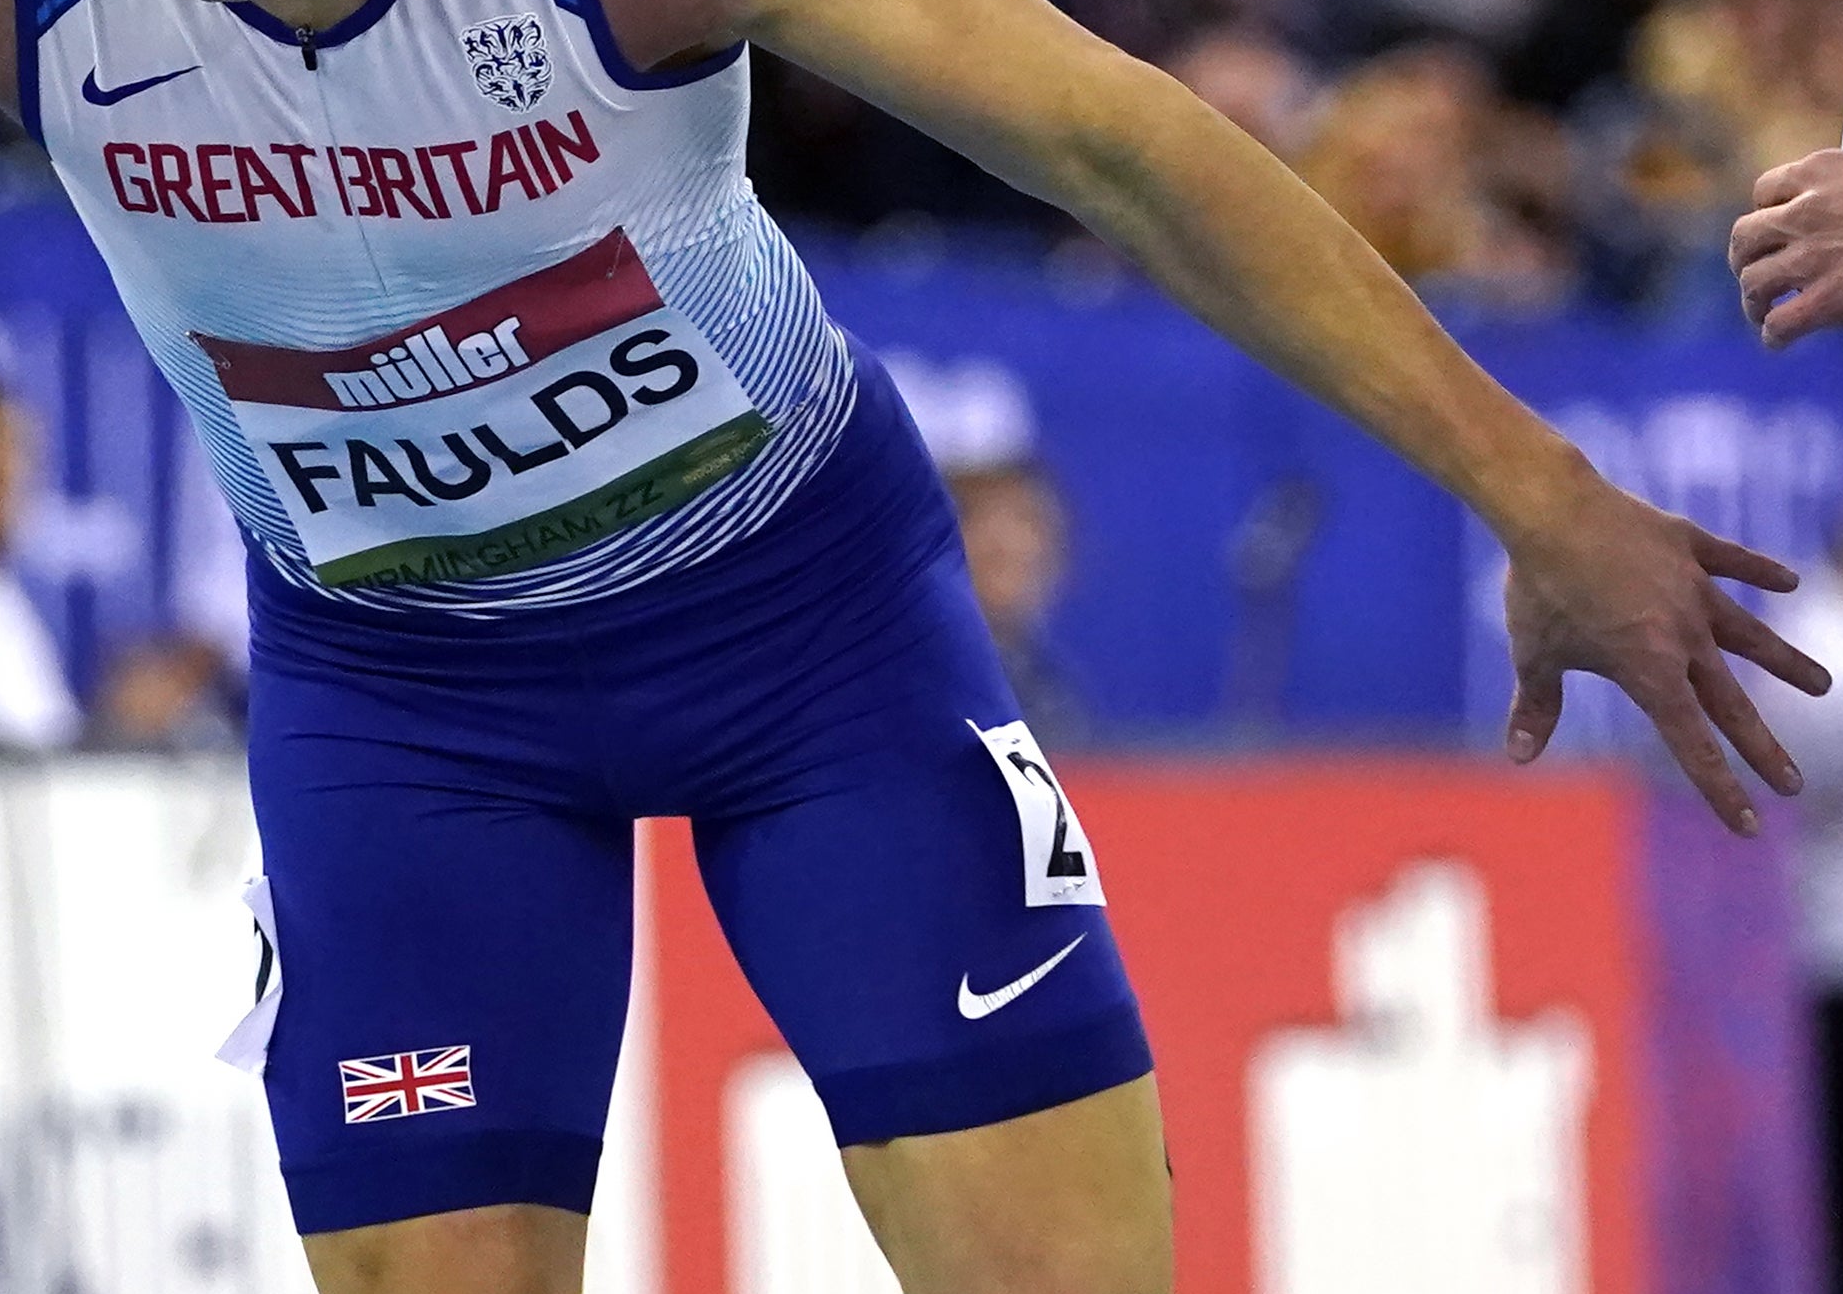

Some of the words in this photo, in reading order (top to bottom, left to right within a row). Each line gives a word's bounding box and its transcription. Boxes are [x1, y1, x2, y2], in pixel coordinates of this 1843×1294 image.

[102, 141, 317, 223] GREAT
[326, 109, 601, 220] BRITAIN
[268, 328, 700, 514] FAULDS
[323, 315, 532, 408] müller
[1006, 750, 1087, 878] 2
